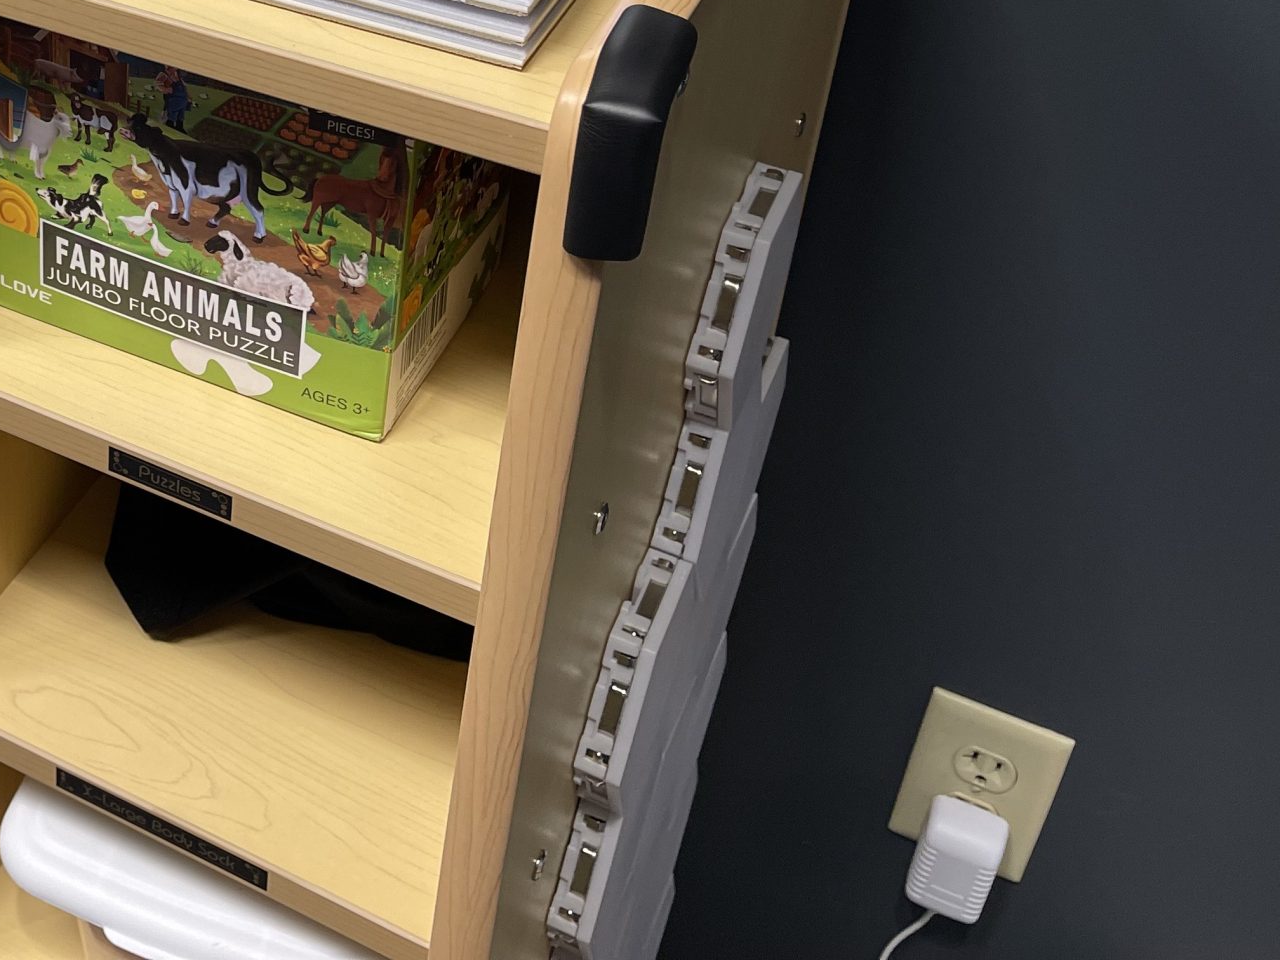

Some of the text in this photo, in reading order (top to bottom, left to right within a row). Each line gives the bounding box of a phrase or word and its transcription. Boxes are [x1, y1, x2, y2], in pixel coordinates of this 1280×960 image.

[327, 119, 376, 140] PIECES!
[45, 266, 296, 368] JUMBO FLOOR PUZZLE
[56, 235, 284, 342] FARM ANIMALS
[300, 386, 371, 417] AGES 3+
[138, 464, 201, 502] Puzzles
[81, 784, 237, 871] X-Large Body Sock
